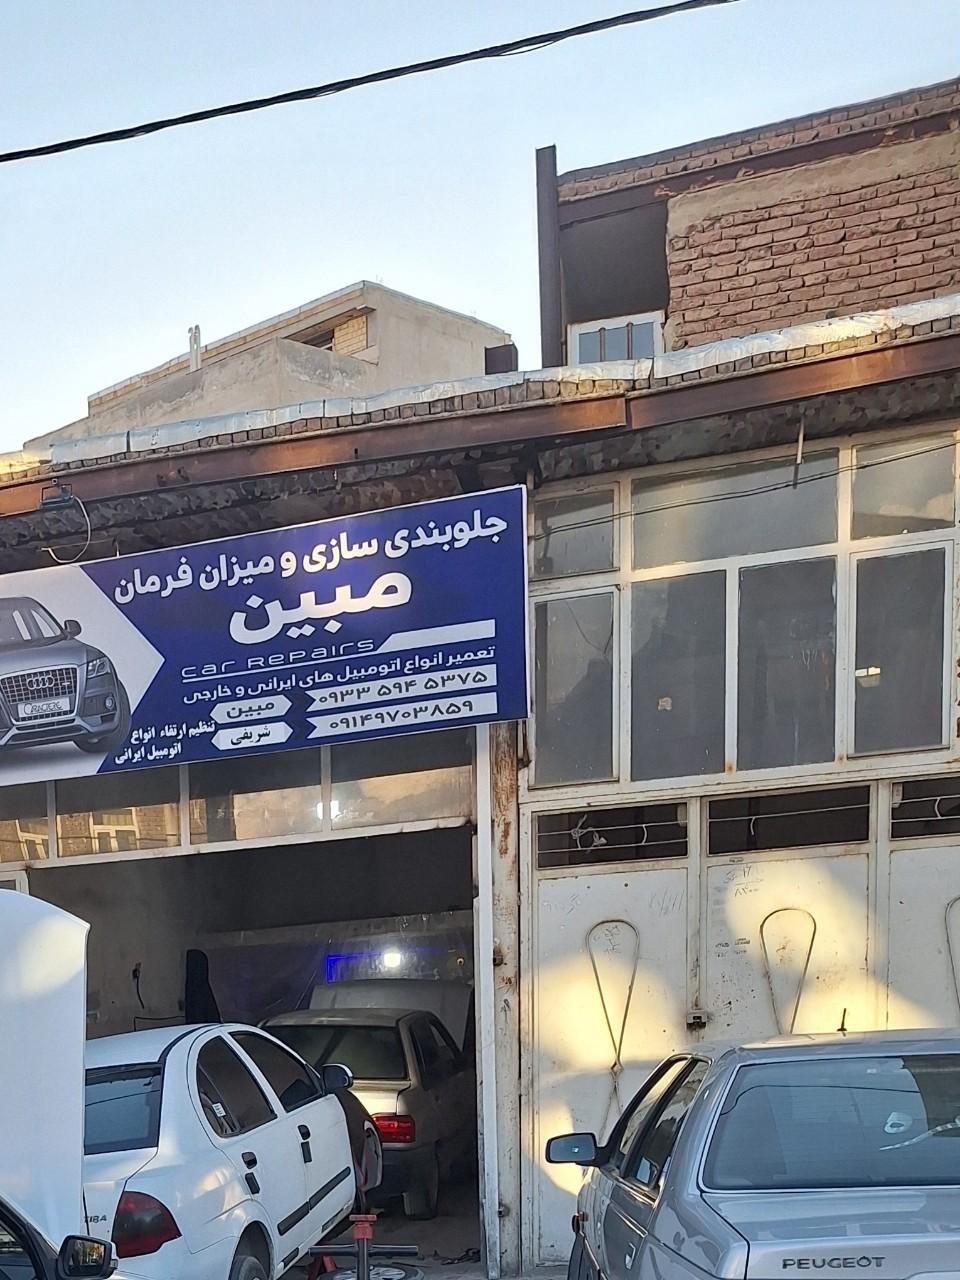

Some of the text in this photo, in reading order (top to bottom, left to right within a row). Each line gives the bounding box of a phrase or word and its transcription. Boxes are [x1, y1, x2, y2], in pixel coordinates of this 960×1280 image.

[113, 509, 508, 604] جلوبندی سازی و میزان فرمان
[229, 567, 413, 645] مبین
[183, 646, 496, 704] تعمیر انواع اتومبیل های ایرانی و خارجی
[318, 670, 488, 704] ۰۹۳۳ ۵۹۴ ۵۳۷۵
[225, 700, 276, 721] مبین
[329, 699, 474, 730] ۰۹۱۴۹۷۰۳۸۵۹
[130, 726, 156, 745] انواع
[188, 720, 216, 739] تنظیم
[230, 727, 272, 746] شریفی
[114, 742, 182, 765] اتومبیل ایرانی
[782, 1255, 886, 1269] PEUGEOT
